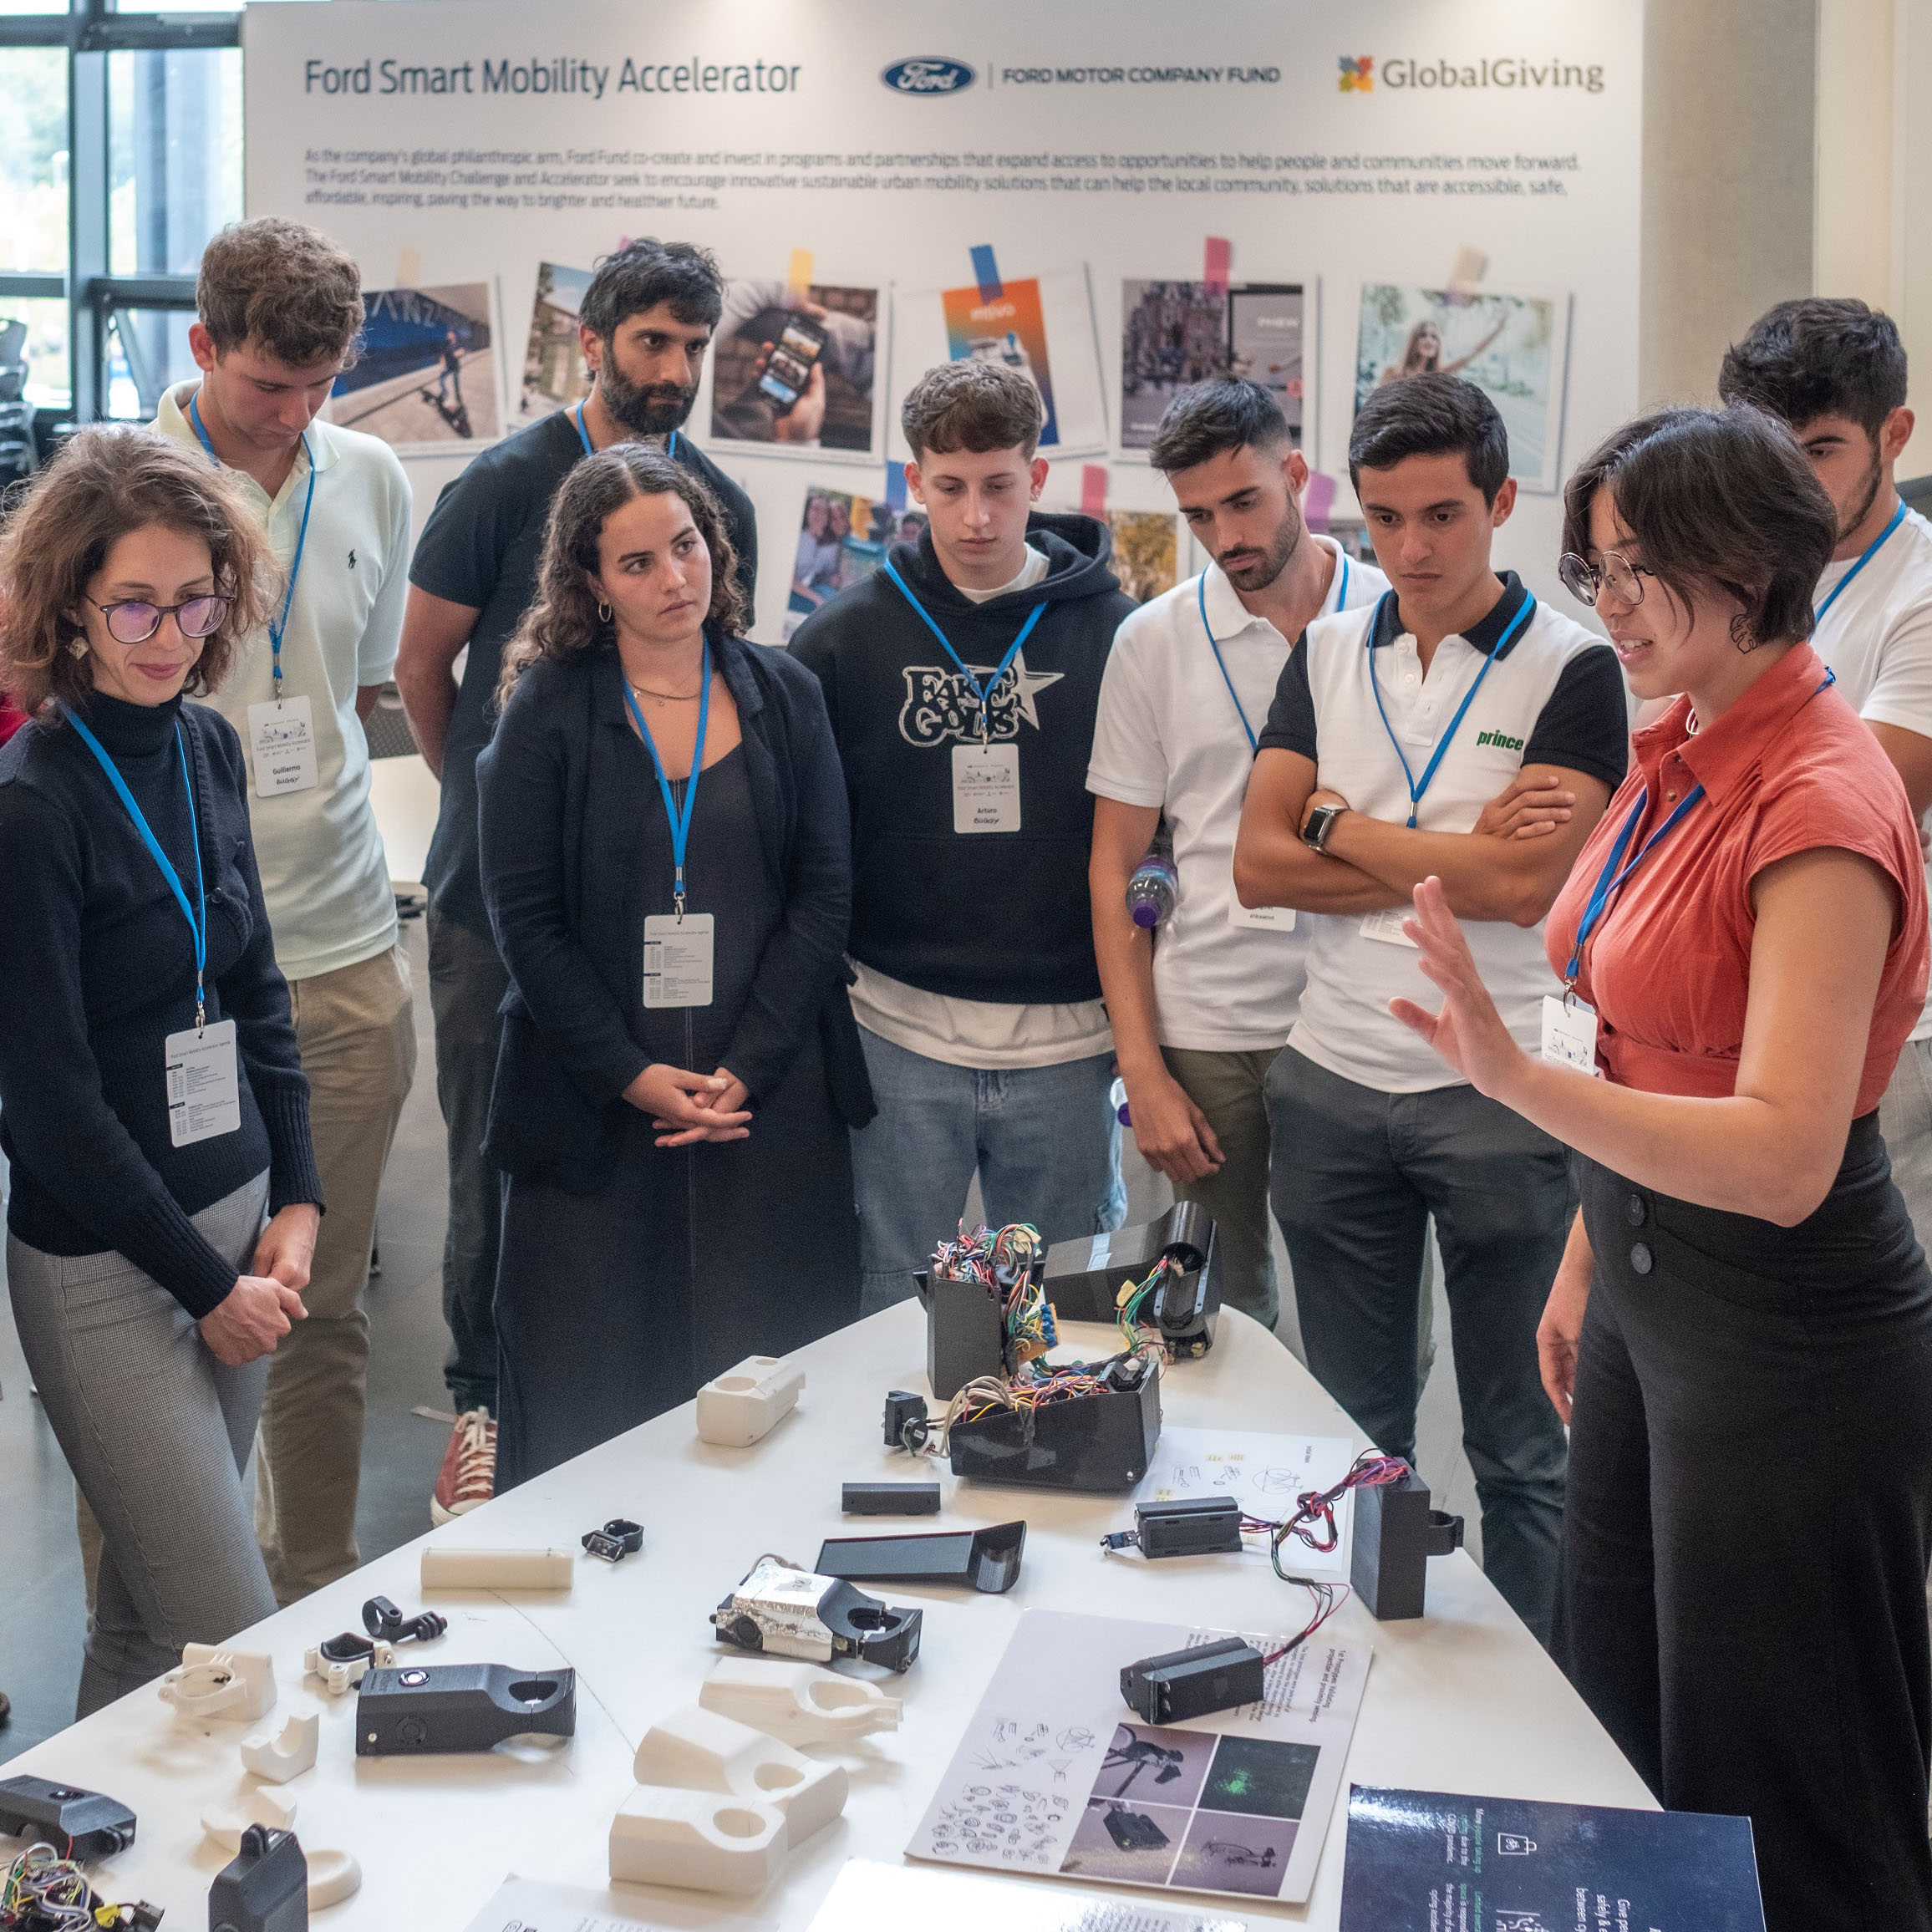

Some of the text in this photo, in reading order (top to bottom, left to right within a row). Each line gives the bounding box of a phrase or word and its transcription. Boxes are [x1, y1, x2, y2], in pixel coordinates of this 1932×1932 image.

[304, 57, 801, 99] Ford Smart Mobility Accelerator
[897, 62, 958, 89] Ford
[1003, 67, 1281, 84] FORD MOTOR COMPANY FUND
[1380, 58, 1605, 94] GlobalGiving
[1477, 730, 1524, 750] prince
[272, 765, 301, 775] Guillermo
[1576, 1888, 1589, 1923] between
[1594, 1894, 1611, 1919] safely
[1617, 1899, 1631, 1919] Give
